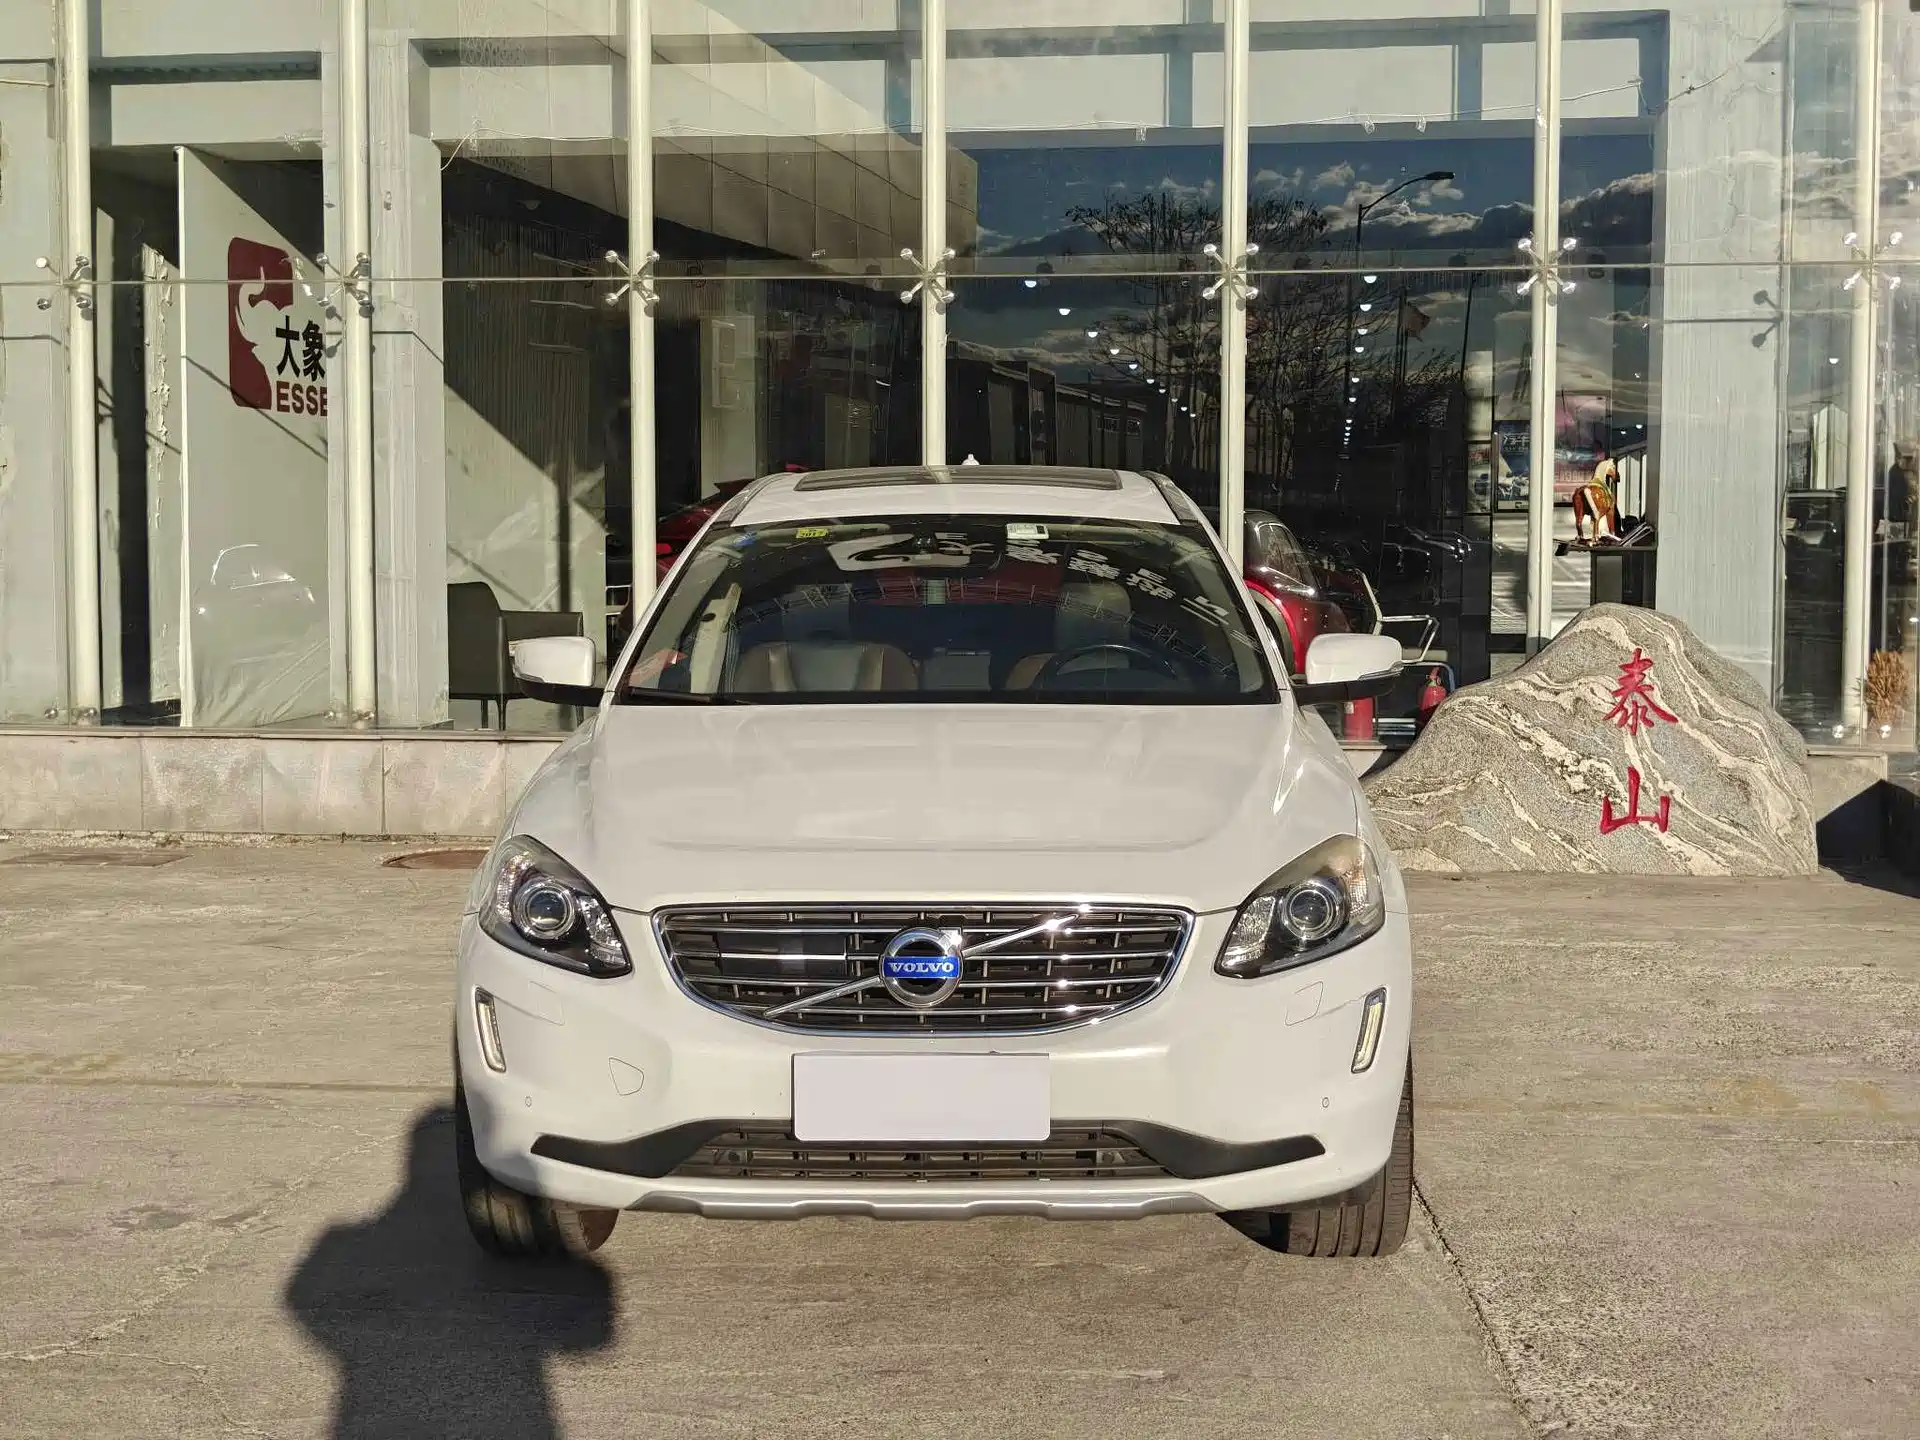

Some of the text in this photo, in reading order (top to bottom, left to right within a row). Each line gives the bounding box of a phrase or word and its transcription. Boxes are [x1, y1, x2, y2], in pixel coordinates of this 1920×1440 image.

[276, 315, 326, 382] 大象
[1600, 647, 1679, 835] 泰山
[888, 962, 954, 973] VOLVO
